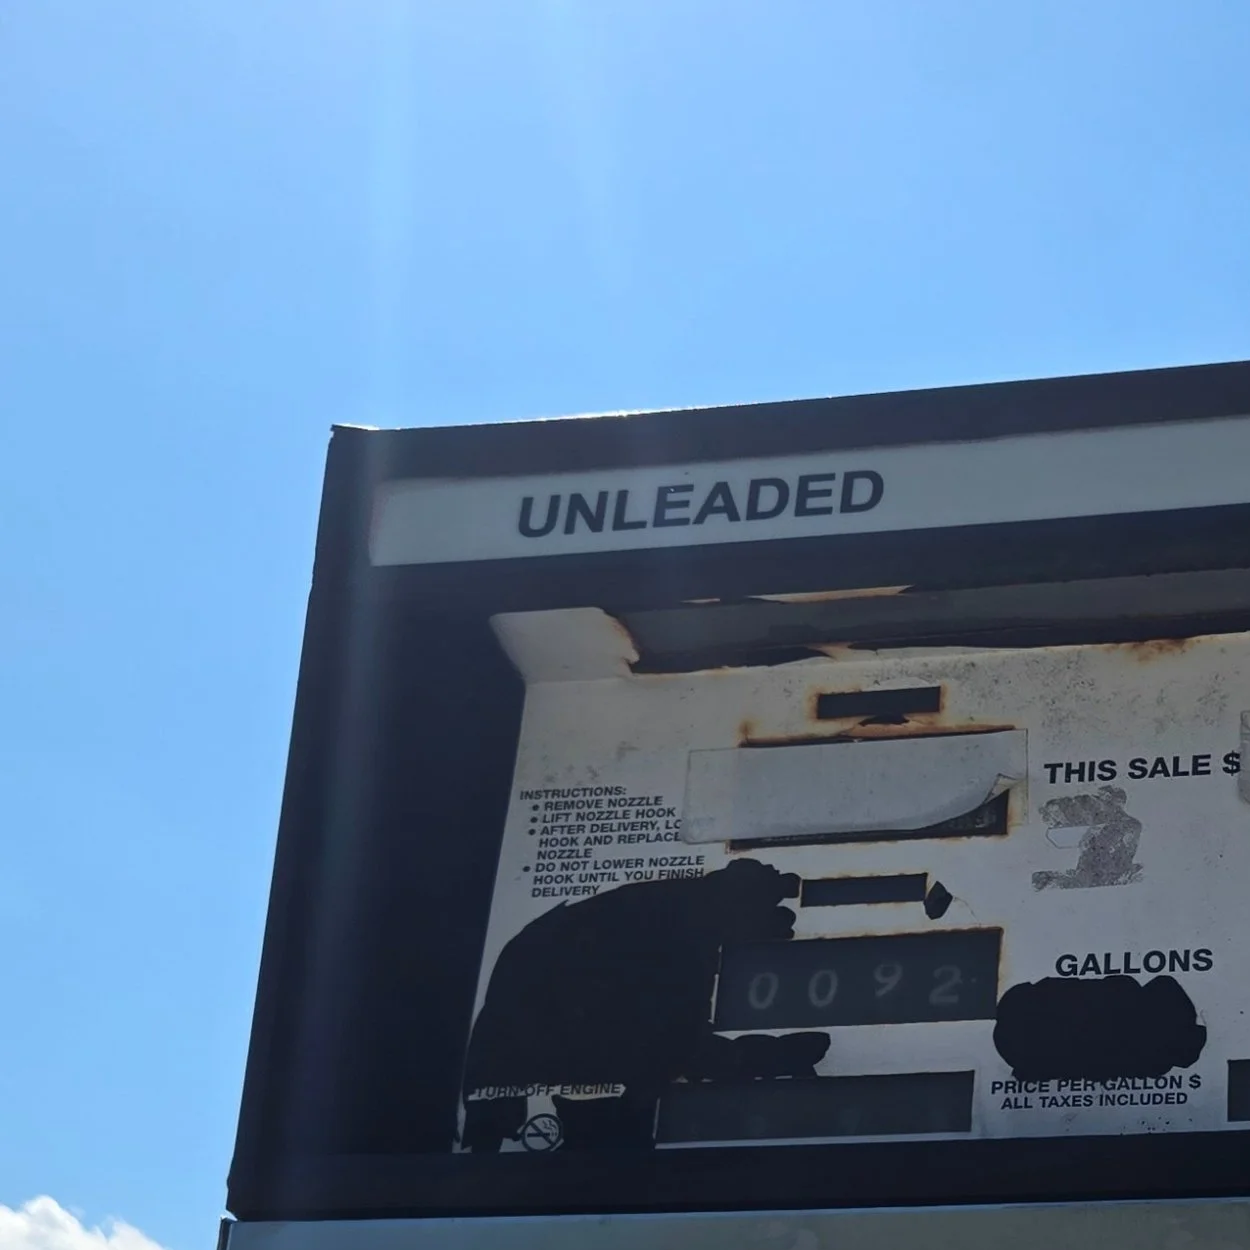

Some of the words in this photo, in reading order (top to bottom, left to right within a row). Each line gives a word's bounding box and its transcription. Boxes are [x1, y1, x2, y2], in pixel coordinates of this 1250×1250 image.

[517, 470, 885, 538] UNLEADED
[1044, 759, 1117, 784] THIS
[1128, 754, 1212, 780] SALE
[1222, 750, 1241, 776] $
[520, 786, 627, 800] INSTRUCTIONS:
[544, 799, 603, 811] REMOVE
[608, 796, 663, 808] NOZZLE
[542, 812, 572, 823] LIFT
[576, 810, 630, 822] NOZZLE
[636, 807, 676, 819] HOOK
[540, 824, 585, 835] AFTER
[590, 821, 660, 833] DELIVERY,
[539, 837, 578, 848] HOOK
[584, 834, 613, 846] AND
[537, 848, 593, 860] NOZZLE
[535, 861, 556, 873] DO
[560, 860, 589, 871] NOT
[594, 858, 644, 870] LOWER
[649, 855, 705, 867] NOZZLE
[533, 874, 573, 885] HOOK
[579, 872, 619, 883] UNTIL
[624, 869, 656, 881] YOU
[659, 868, 704, 880] FINISH
[531, 885, 600, 898] DELIVERY
[1055, 948, 1213, 977] GALLONS
[525, 1085, 555, 1096] OFF
[560, 1084, 621, 1096] ENGINE
[991, 1080, 1050, 1095] PRICE
[1057, 1079, 1096, 1092] PER
[1103, 1076, 1183, 1091] GALLON
[1189, 1074, 1202, 1090] $
[1000, 1097, 1033, 1110] ALL
[1039, 1095, 1094, 1109] TAXES
[1099, 1092, 1188, 1106] INCLUDED
